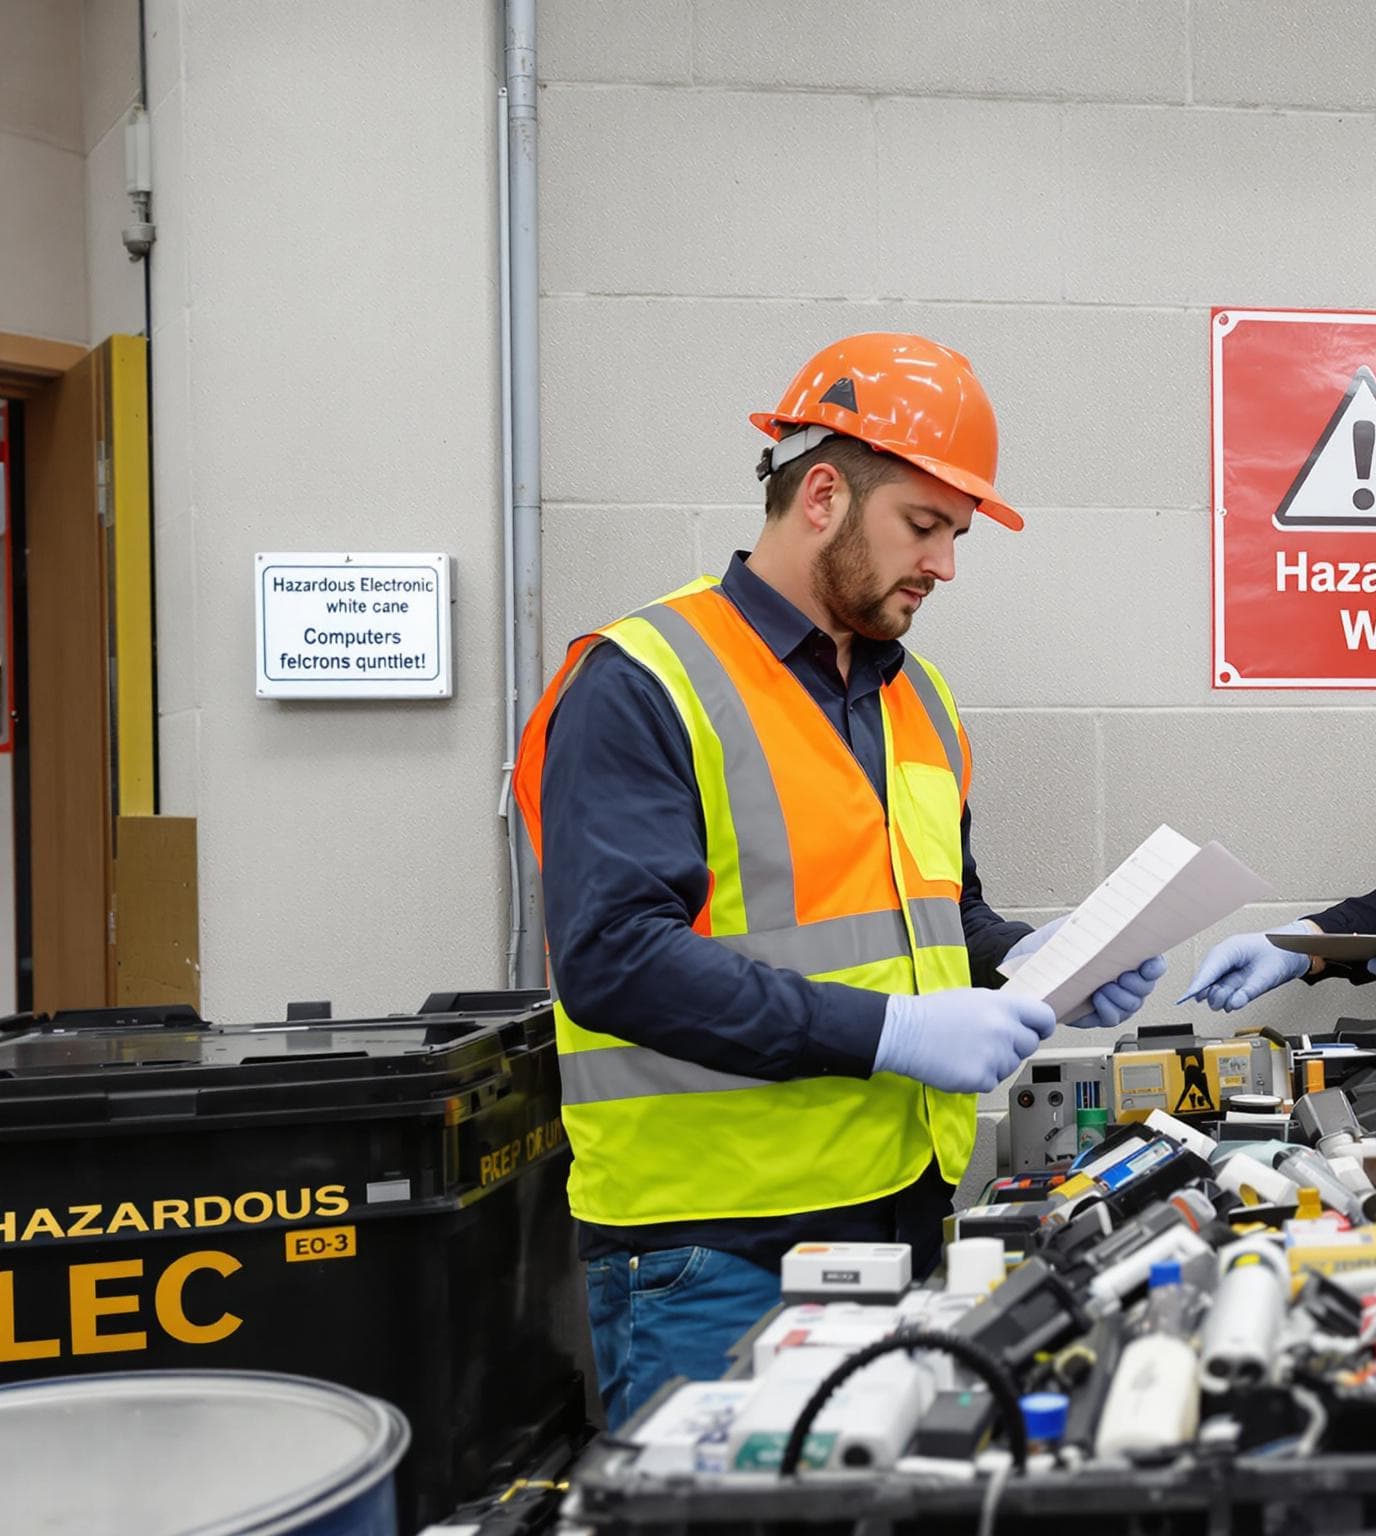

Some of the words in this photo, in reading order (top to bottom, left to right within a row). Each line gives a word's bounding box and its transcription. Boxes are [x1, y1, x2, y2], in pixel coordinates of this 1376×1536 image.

[273, 577, 356, 592] Hazardous
[360, 577, 434, 592] Electronic
[326, 599, 367, 613] white
[372, 601, 409, 613] cane
[303, 627, 402, 648] Computers
